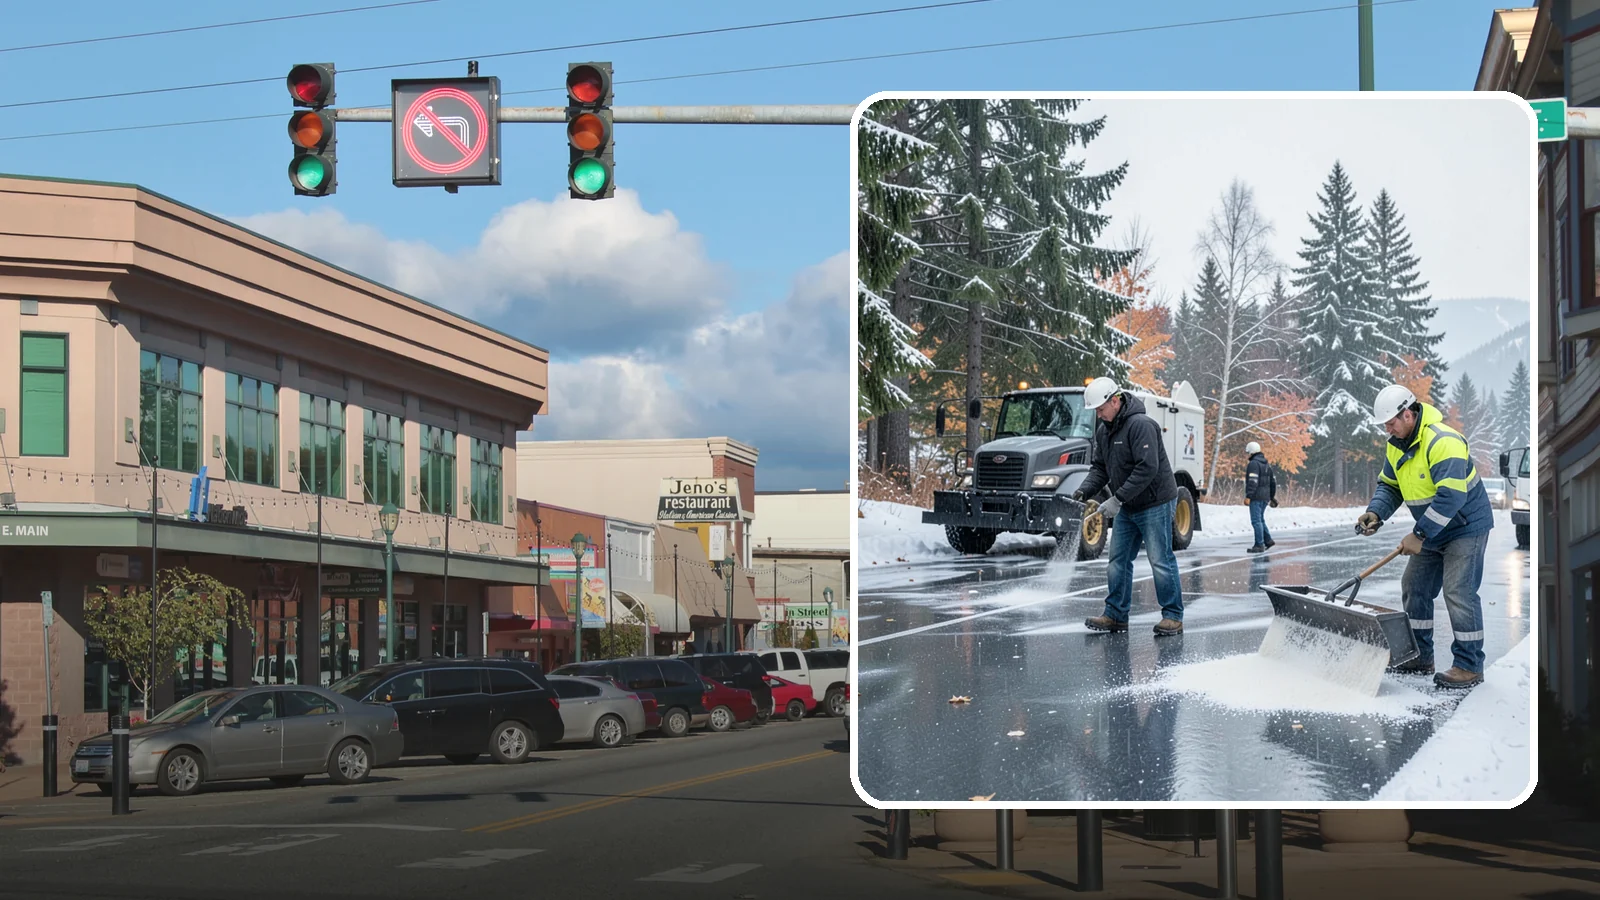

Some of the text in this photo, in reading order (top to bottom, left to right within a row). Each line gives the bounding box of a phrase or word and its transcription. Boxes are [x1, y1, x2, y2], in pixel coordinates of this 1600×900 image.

[669, 480, 728, 494] Jeno's
[665, 496, 731, 509] restaurant
[658, 510, 682, 520] Italian
[686, 510, 714, 520] American
[715, 509, 738, 520] Cuisine
[2, 525, 49, 536] E. MAIN
[797, 607, 828, 617] Street
[791, 619, 824, 627] lass
